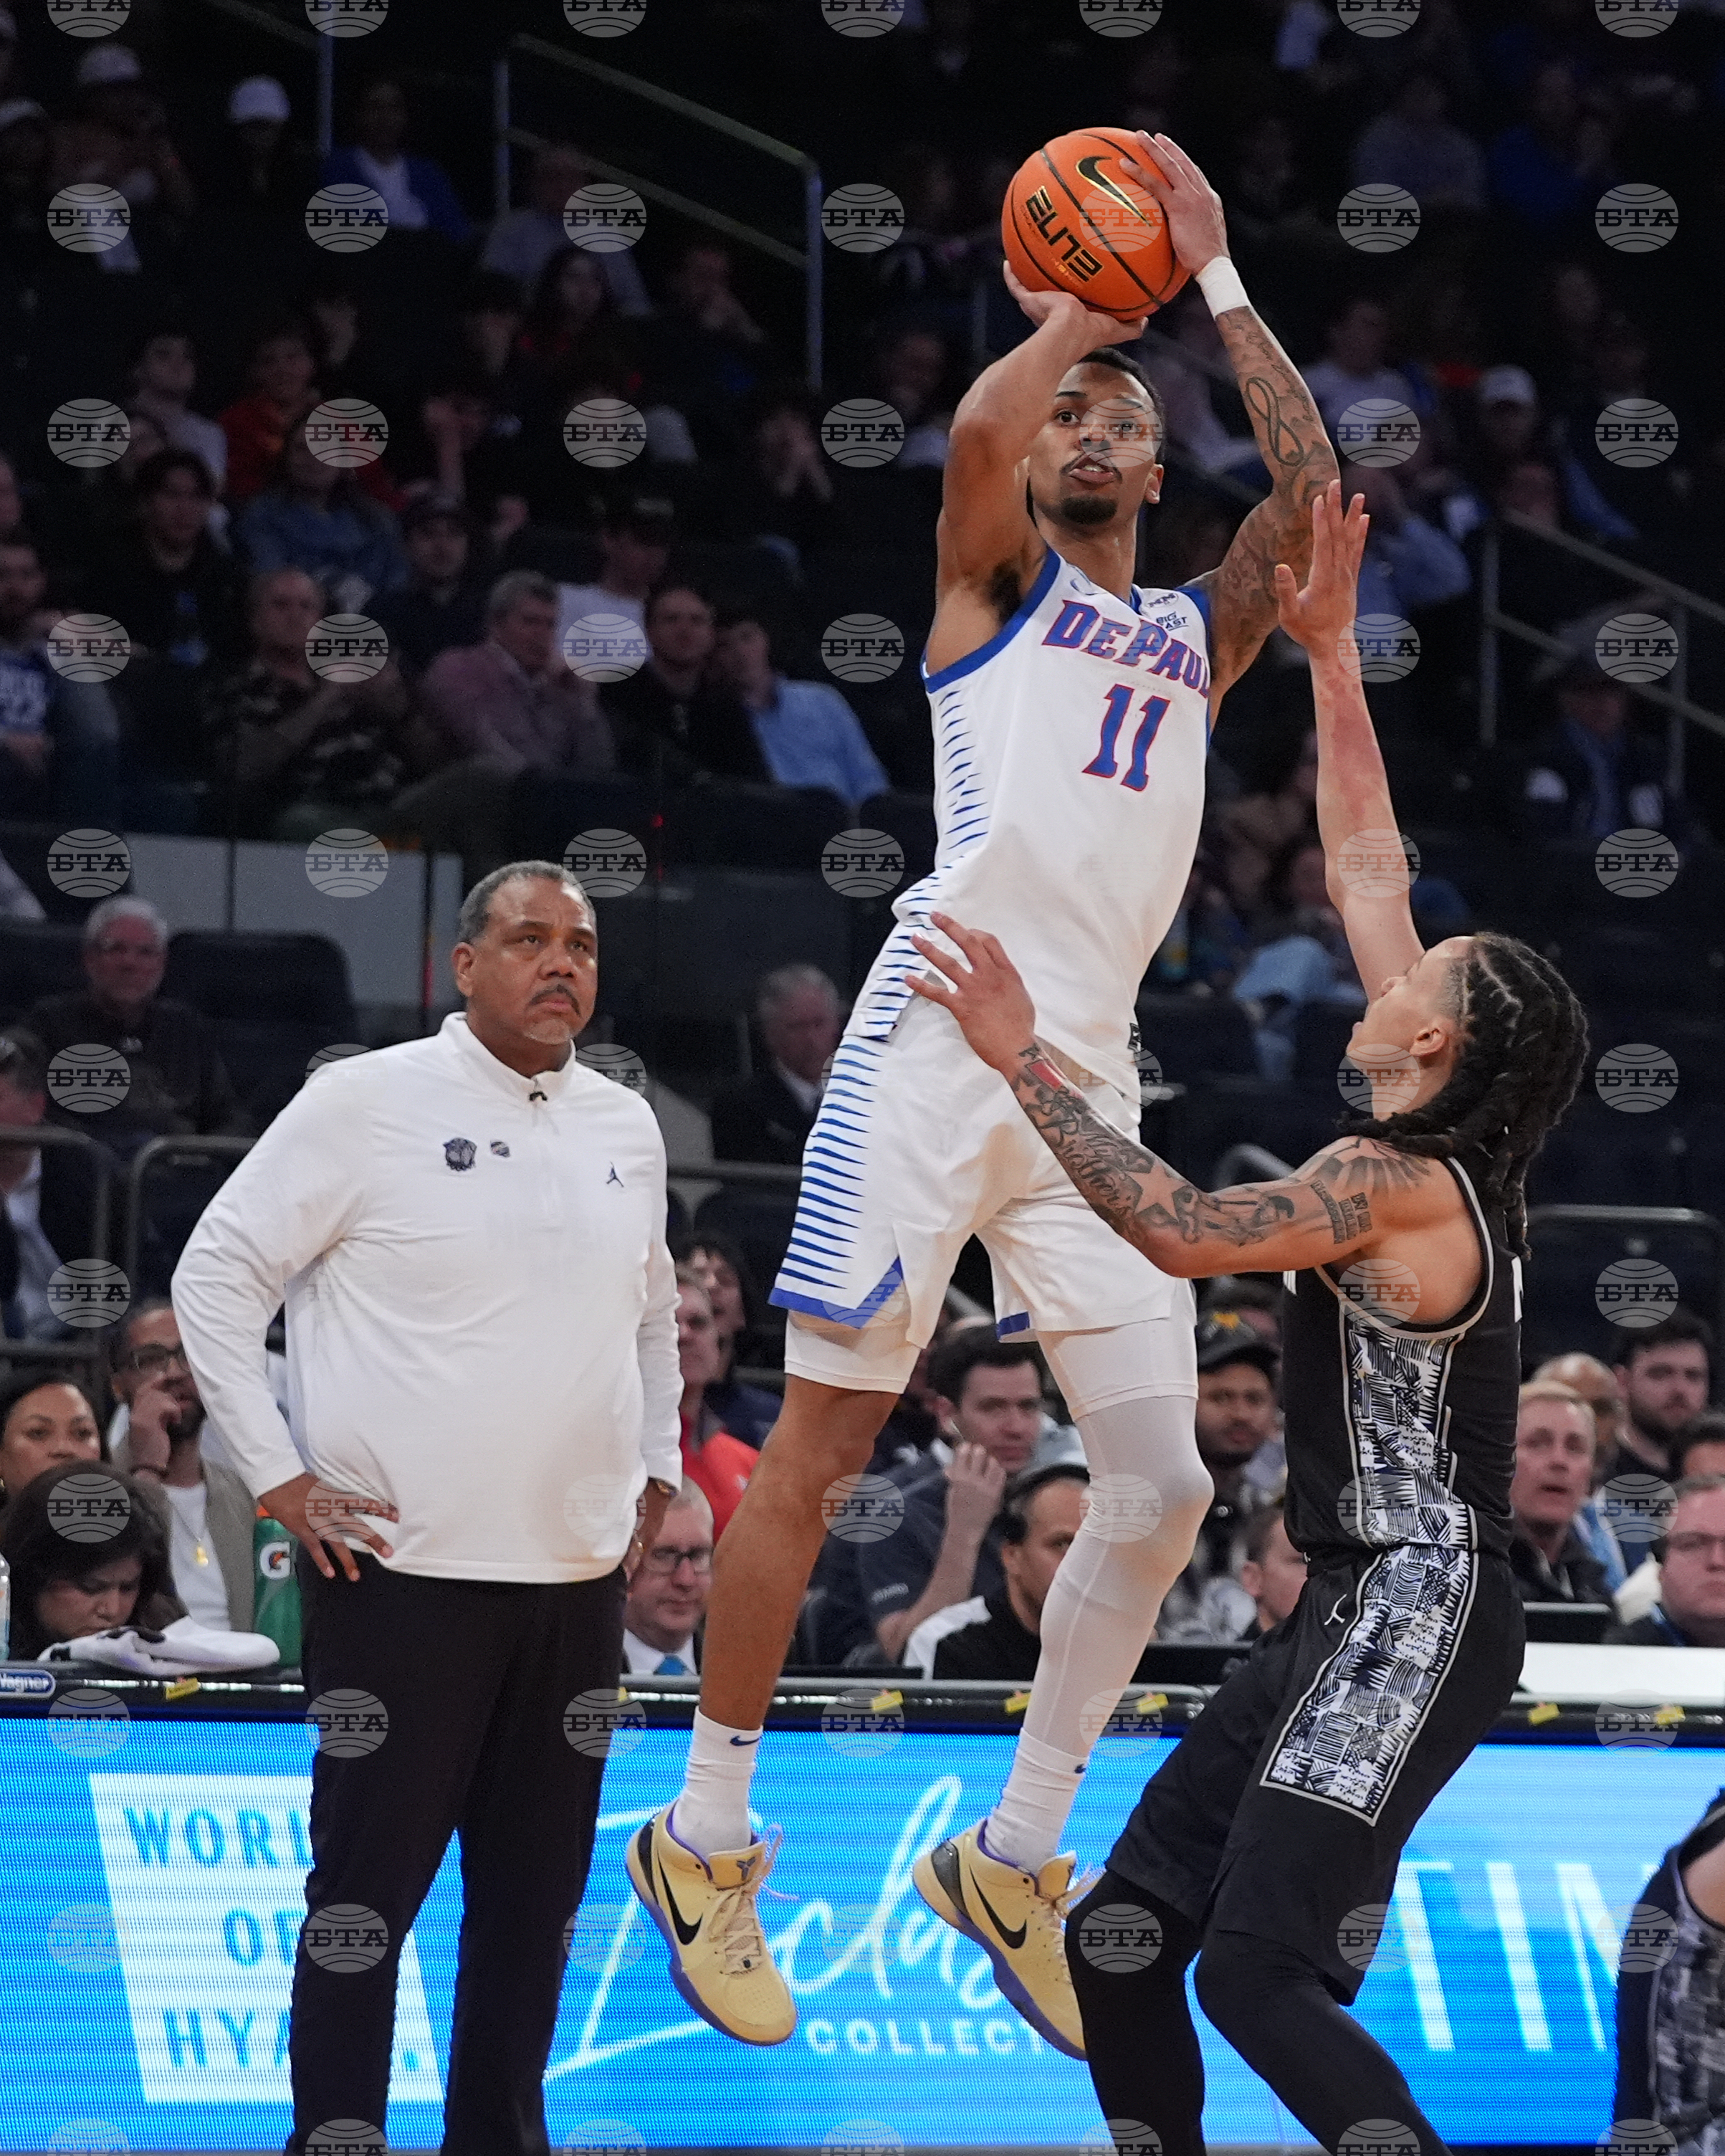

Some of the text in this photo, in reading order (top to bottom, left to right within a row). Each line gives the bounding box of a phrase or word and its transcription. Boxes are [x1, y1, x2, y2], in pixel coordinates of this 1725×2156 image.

[1026, 186, 1104, 282] ELITE
[1081, 683, 1171, 792] 11
[259, 1542, 290, 1580] G
[124, 1808, 315, 1868] WORL
[806, 2016, 1042, 2056] COLLECT
